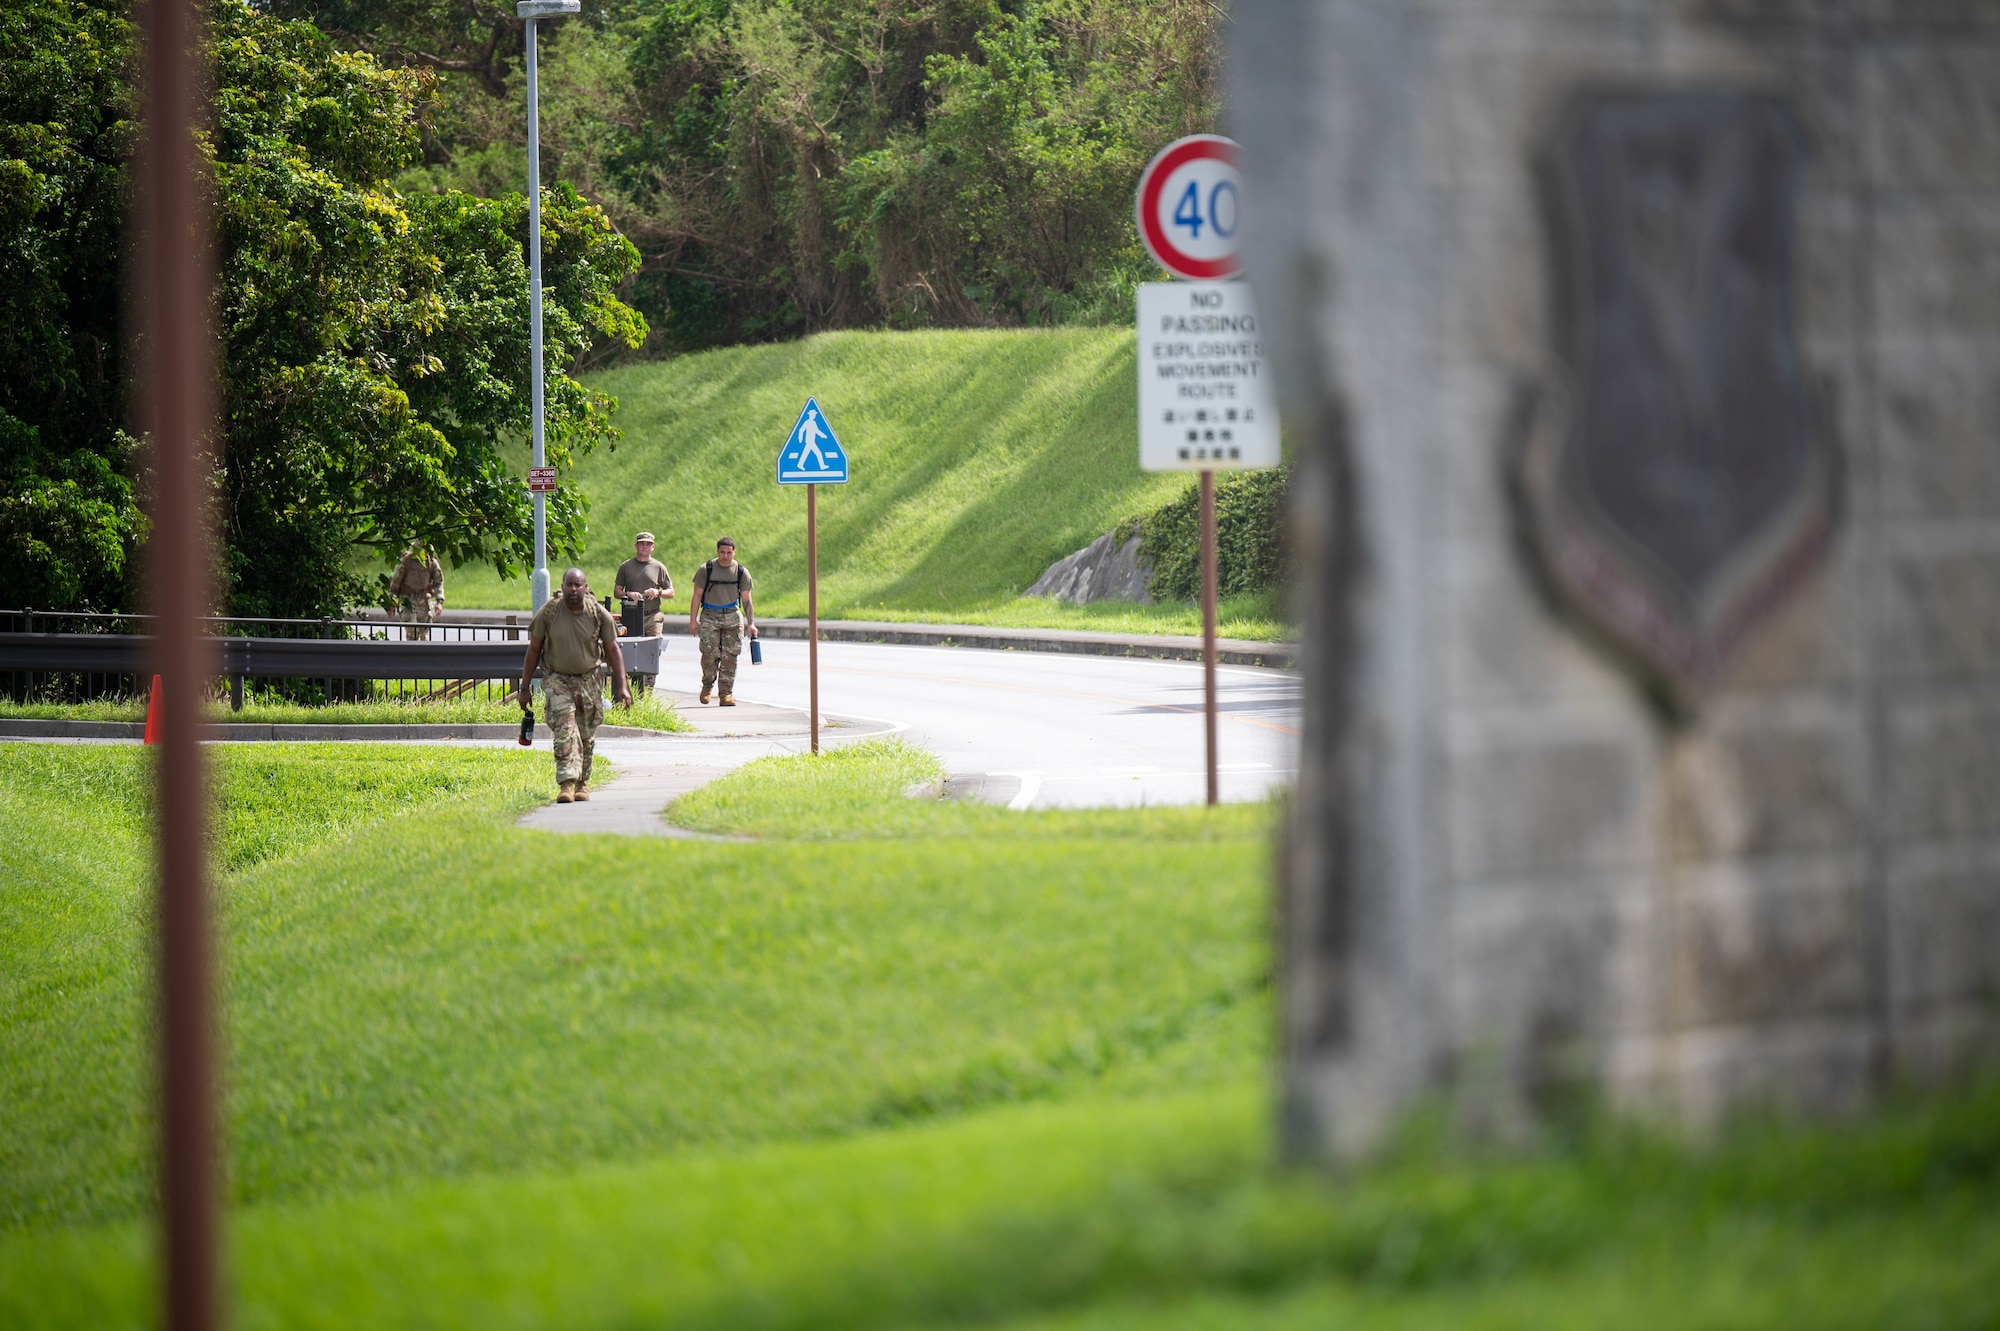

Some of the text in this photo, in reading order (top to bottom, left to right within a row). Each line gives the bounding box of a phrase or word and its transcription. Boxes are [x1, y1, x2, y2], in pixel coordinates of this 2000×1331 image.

[1173, 180, 1240, 239] 40
[1190, 290, 1223, 309] NO
[1161, 315, 1256, 333] PASSING
[1153, 342, 1265, 359] EXPLOSIVES
[1157, 361, 1261, 379] MOVEMENT
[1178, 383, 1238, 399] ROUTE
